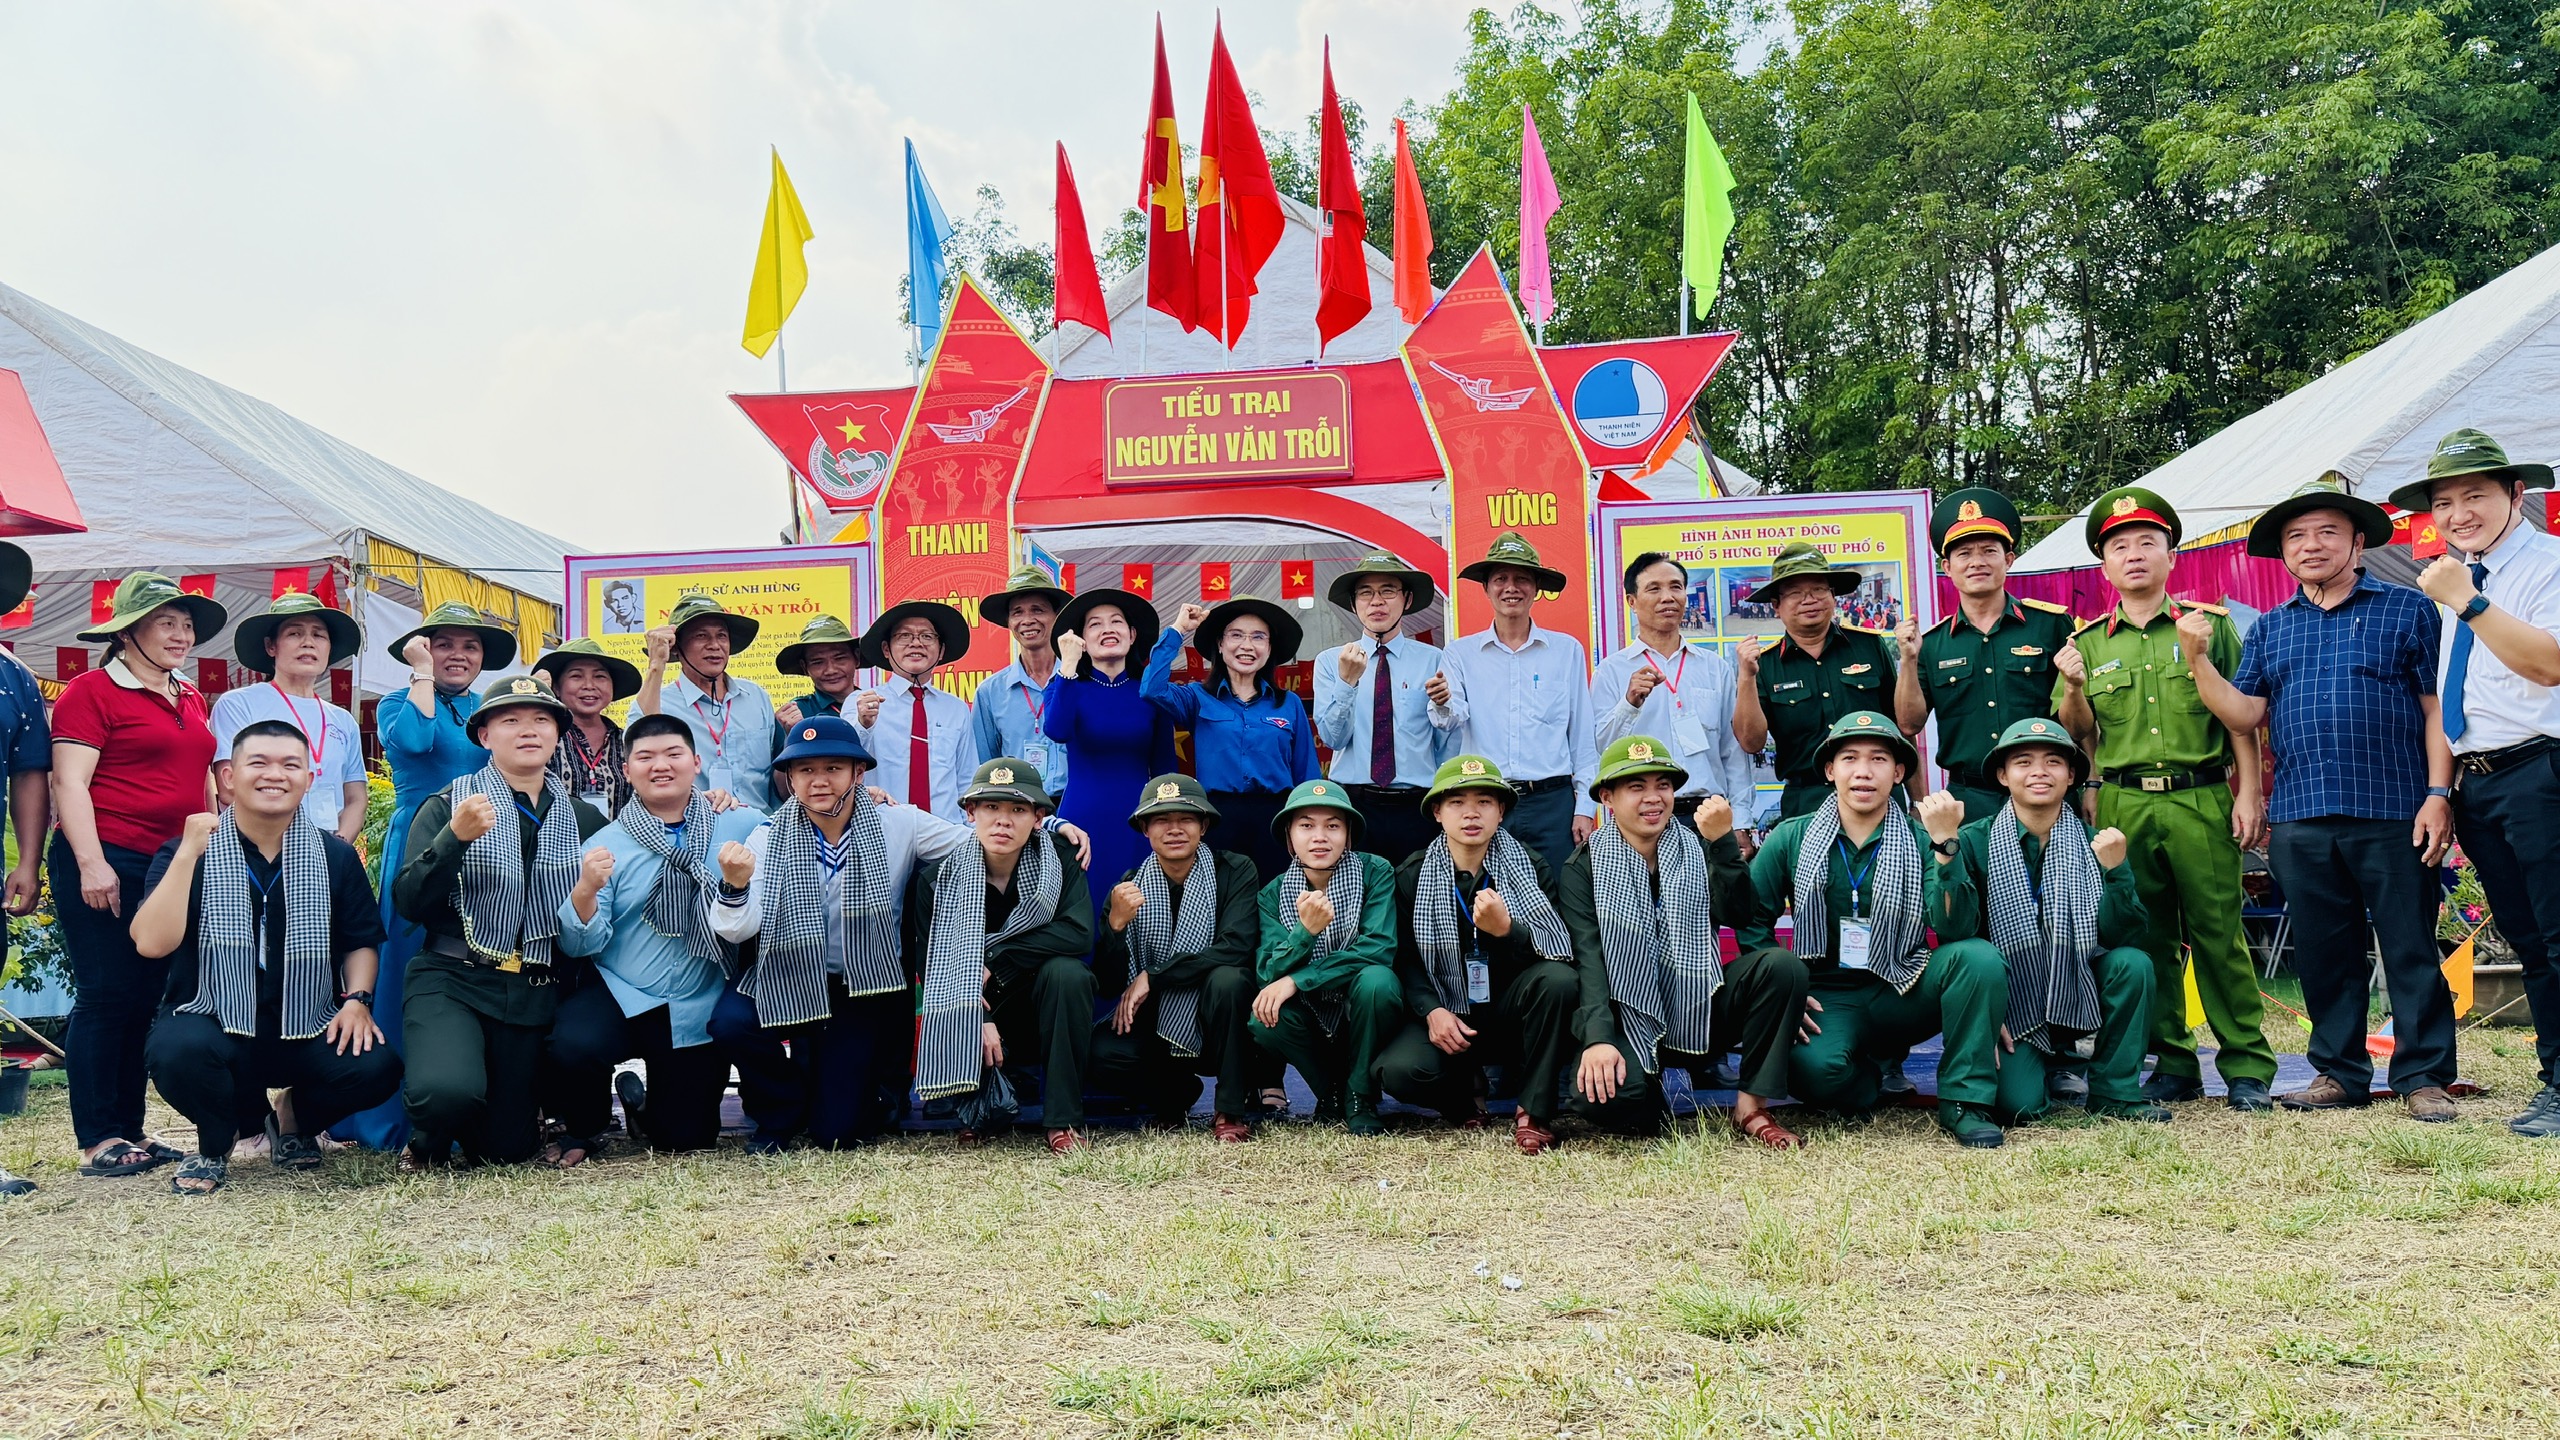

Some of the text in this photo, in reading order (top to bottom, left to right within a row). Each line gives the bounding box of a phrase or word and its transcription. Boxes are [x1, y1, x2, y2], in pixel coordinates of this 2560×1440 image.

[1162, 386, 1290, 418] TIỂU TRẠI
[1115, 416, 1341, 467] NGUYỄN VĂN TRỖI
[1486, 487, 1558, 528] VỮNG
[906, 522, 989, 556] THANH
[1681, 523, 1841, 543] HÌNH ẢNH HOẠT ĐỘNG
[1675, 545, 1704, 561] PHỐ
[1709, 549, 1718, 560] 5
[1722, 546, 1762, 559] HƯNG
[1812, 544, 1837, 554] HU
[1842, 538, 1871, 554] PHỐ
[1876, 542, 1885, 552] 6
[712, 583, 729, 595] SỬ
[732, 585, 759, 595] ANH
[763, 582, 800, 593] HÙNG
[737, 603, 773, 616] VĂN
[777, 598, 821, 614] TRỖI
